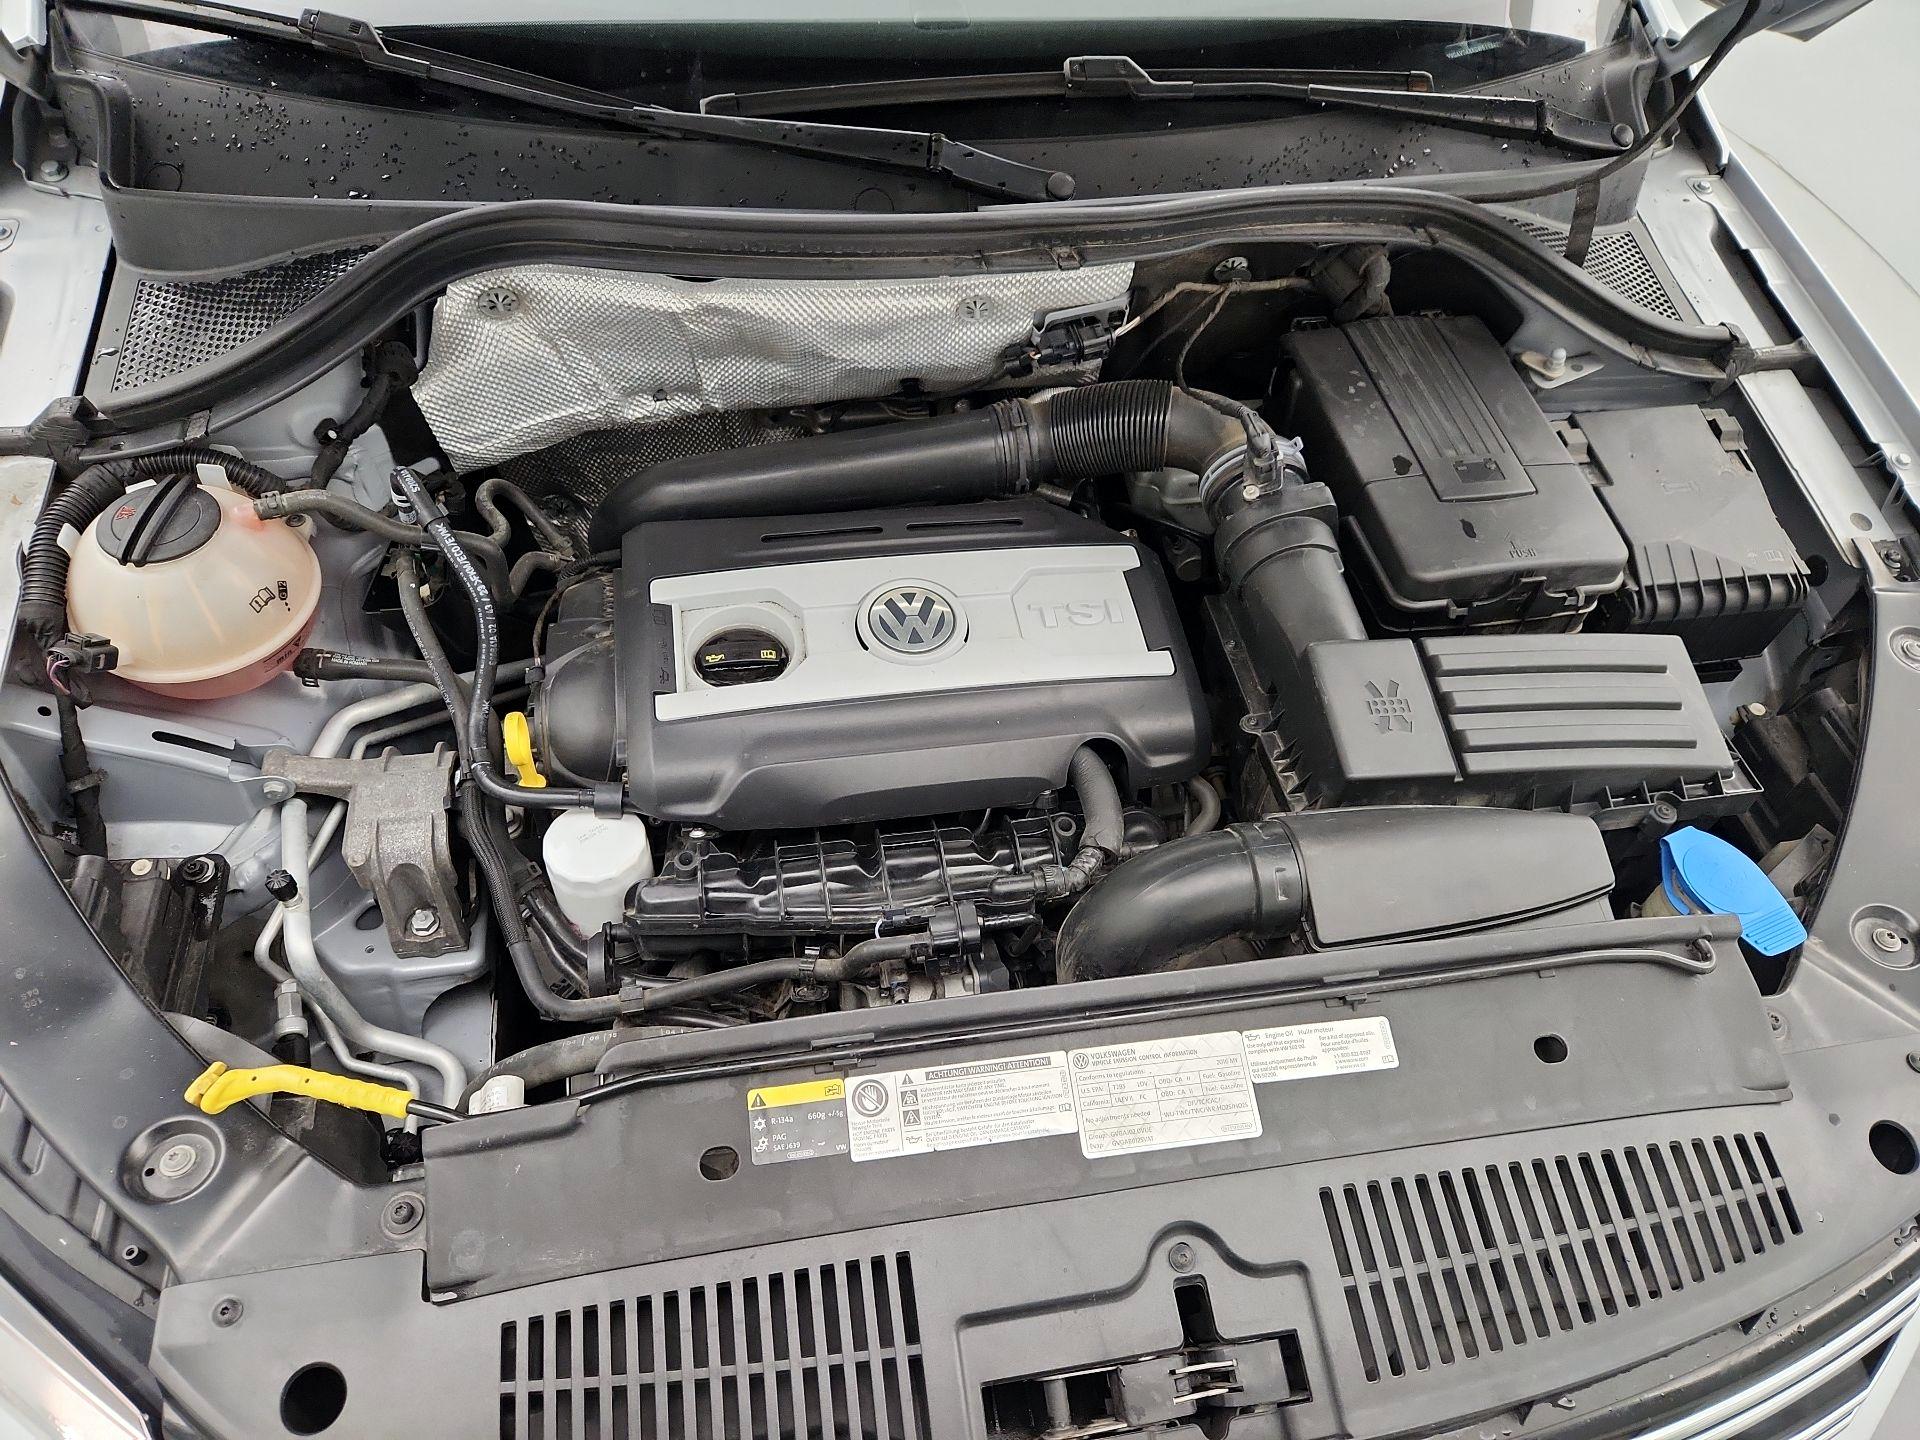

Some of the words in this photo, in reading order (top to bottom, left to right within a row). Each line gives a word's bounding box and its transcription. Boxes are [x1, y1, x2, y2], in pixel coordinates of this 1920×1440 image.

[1509, 548, 1537, 558] PUSH
[1027, 598, 1125, 629] TSI
[1090, 1049, 1136, 1060] VOLKSWAGEN
[928, 1069, 967, 1080] ACHTUNG!
[968, 1063, 1008, 1075] WARNING!
[1009, 1058, 1049, 1070] ATTENTION!
[771, 1115, 794, 1125] R-134a
[808, 1111, 826, 1122] 660g
[772, 1133, 787, 1141] PAG
[773, 1144, 785, 1152] SAE
